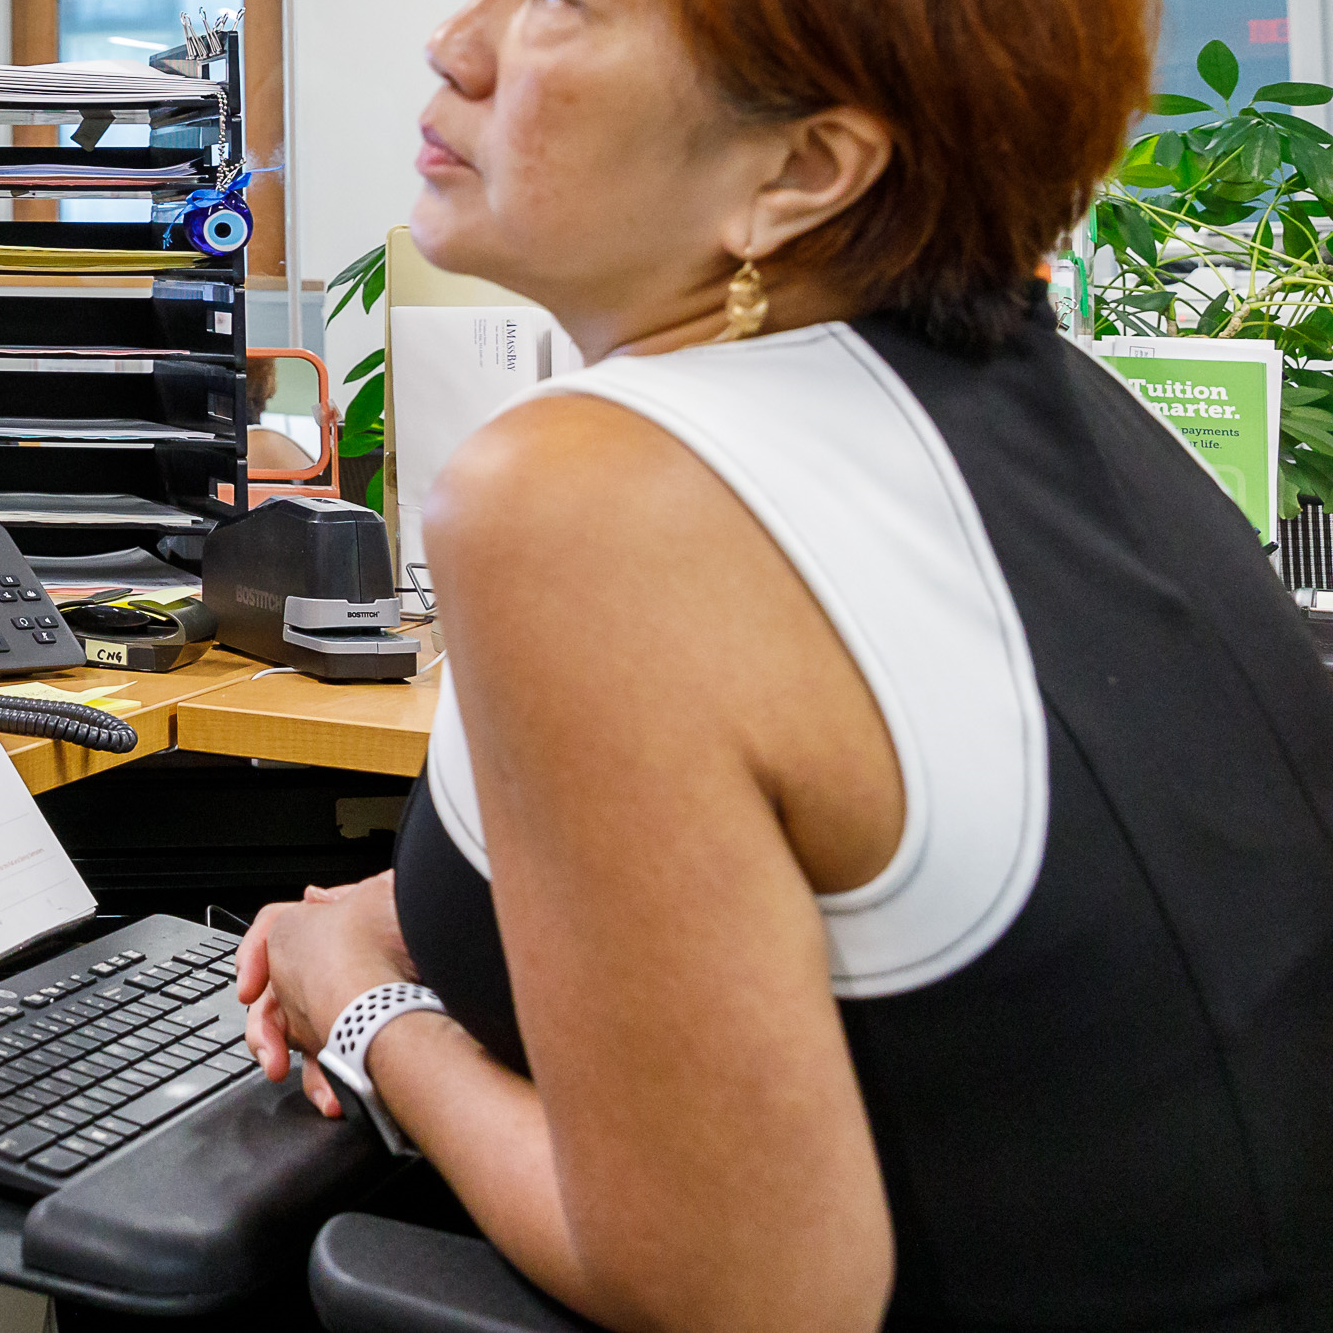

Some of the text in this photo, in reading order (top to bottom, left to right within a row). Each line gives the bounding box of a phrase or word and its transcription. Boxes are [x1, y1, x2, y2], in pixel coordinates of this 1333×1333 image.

[1128, 378, 1229, 401] Tuition
[1148, 400, 1241, 420] marter.
[1181, 426, 1240, 438] payments
[1200, 439, 1223, 449] life.
[235, 585, 283, 614] BOSTITCH
[97, 649, 122, 663] CNG
